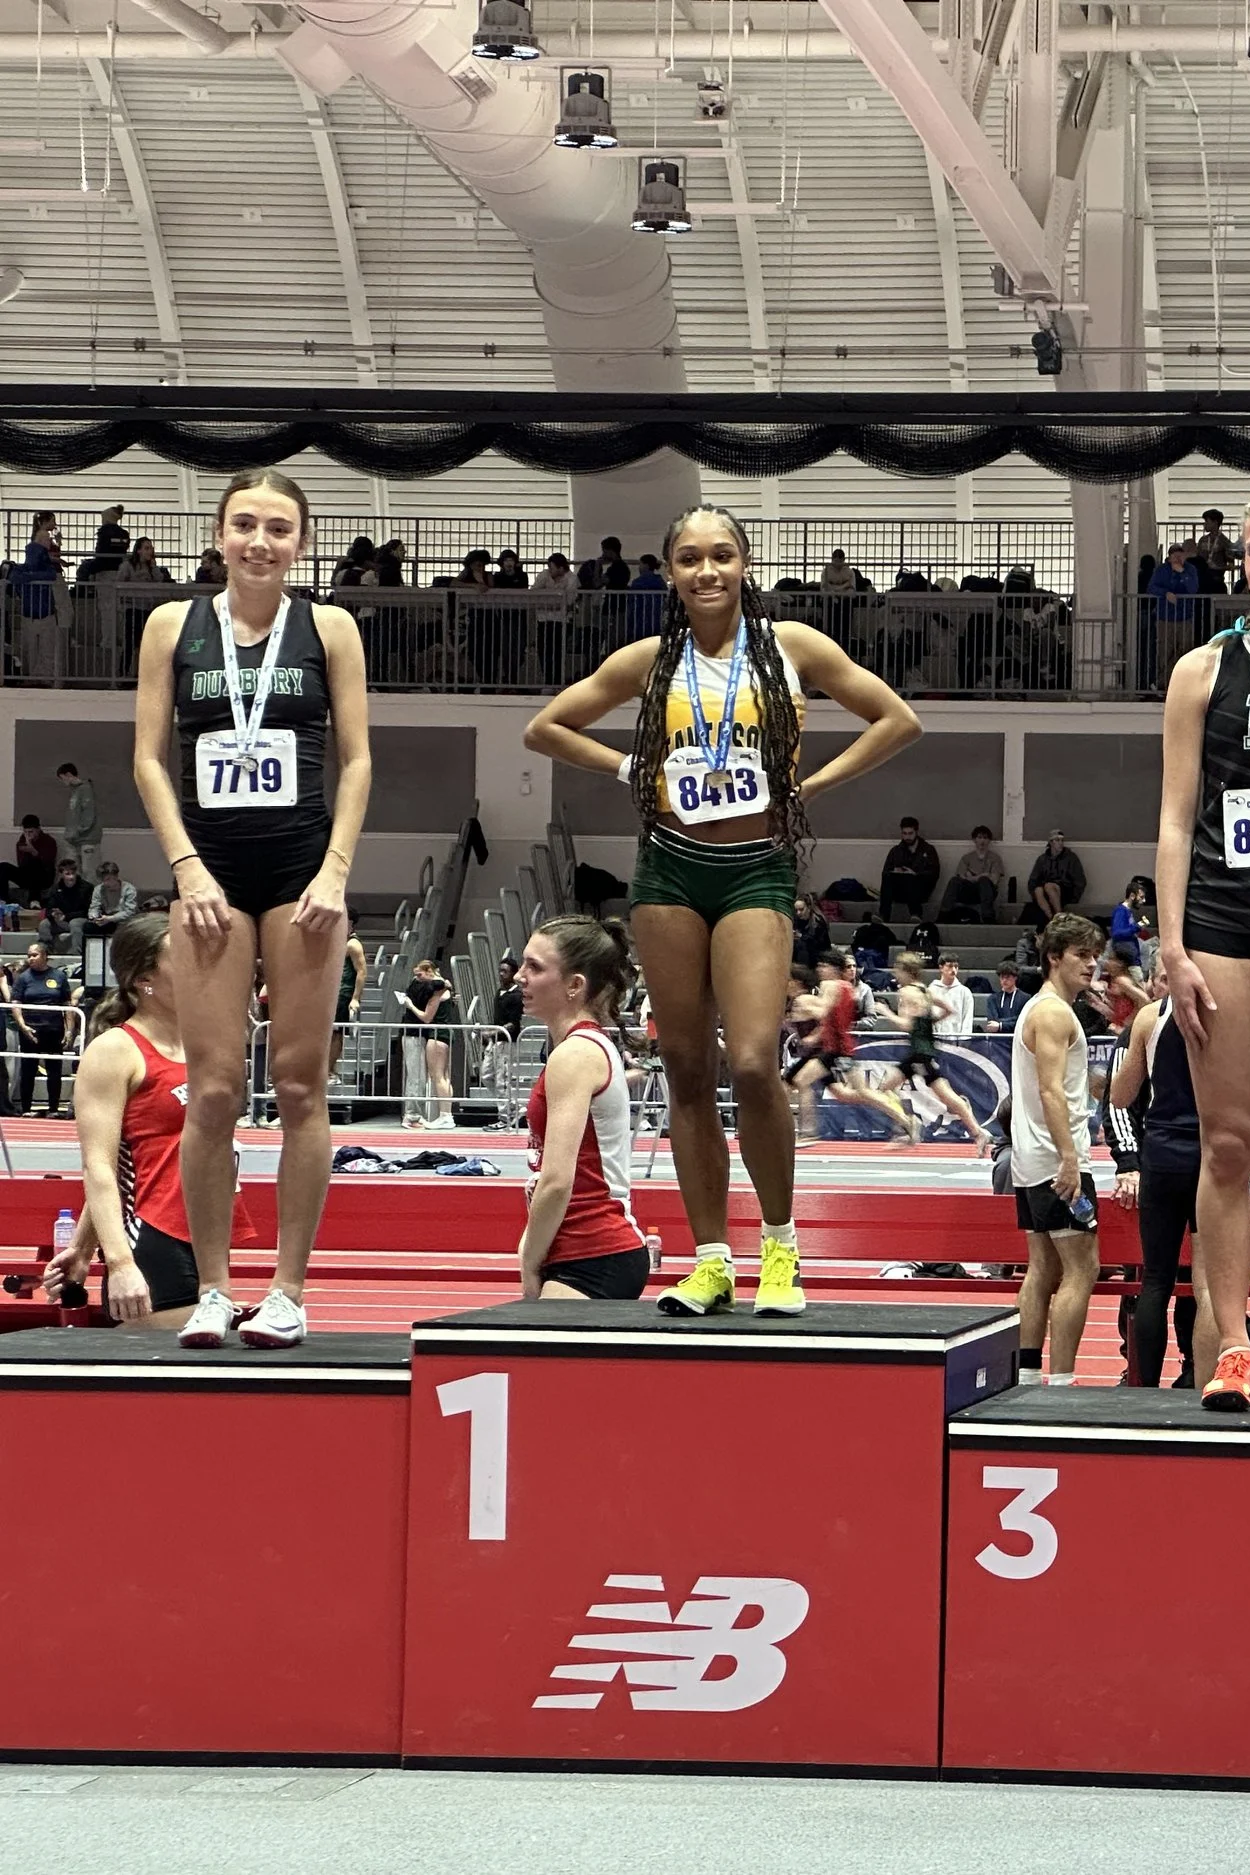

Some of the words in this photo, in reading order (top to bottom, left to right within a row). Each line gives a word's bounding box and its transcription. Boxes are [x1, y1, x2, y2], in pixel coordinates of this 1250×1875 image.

[192, 667, 303, 701] DUBRY
[208, 757, 282, 794] 7719
[678, 767, 758, 812] 8413
[436, 1372, 509, 1541] 1
[974, 1466, 1059, 1580] 3
